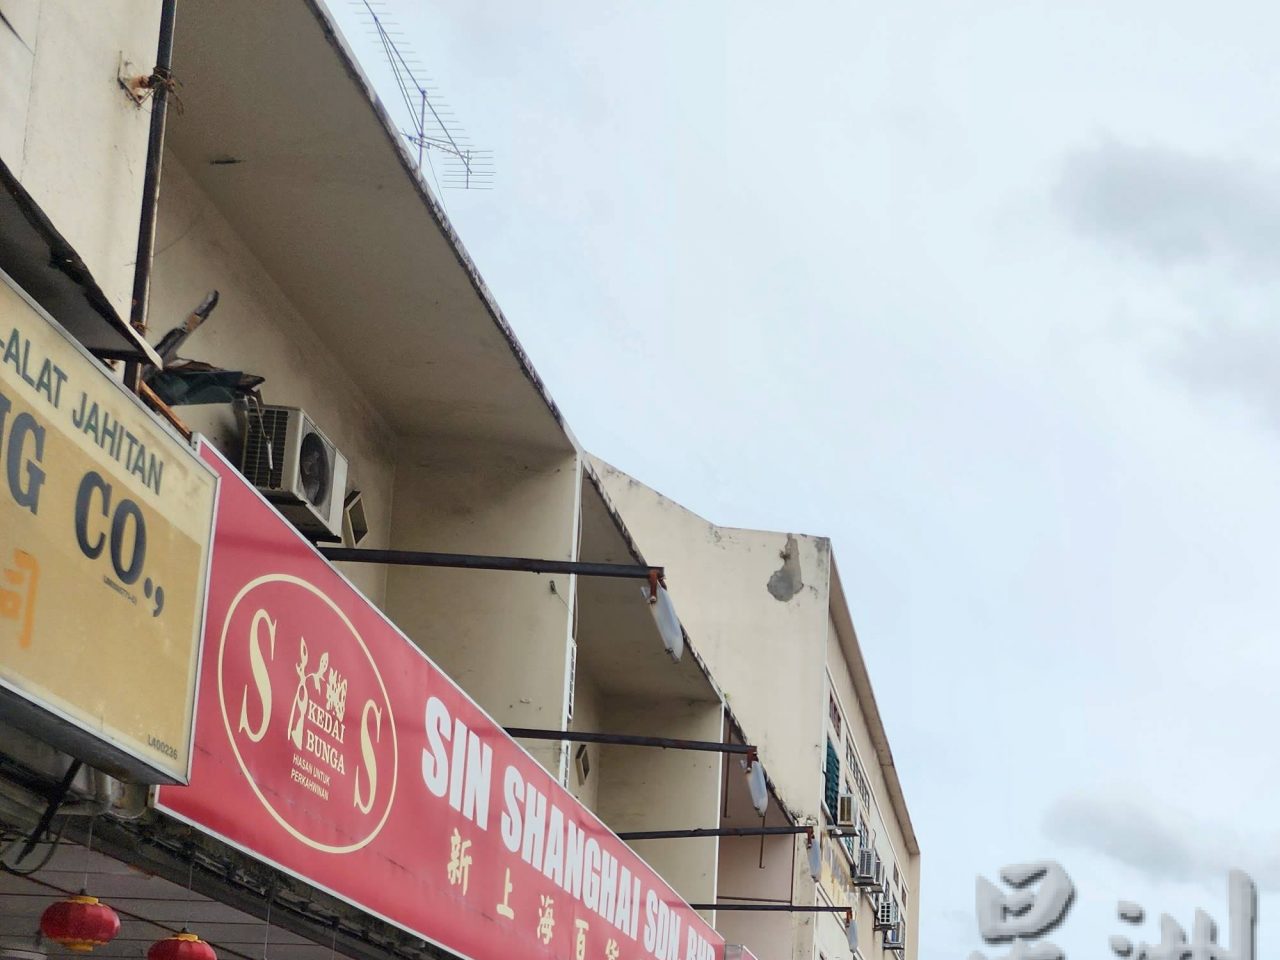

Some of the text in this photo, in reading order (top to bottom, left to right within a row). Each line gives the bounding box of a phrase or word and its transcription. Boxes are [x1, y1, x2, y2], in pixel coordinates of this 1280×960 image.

[72, 391, 164, 497] JAHITAN
[238, 608, 278, 743] S
[305, 729, 346, 776] BUNGA
[308, 699, 346, 744] KEDAI
[353, 698, 383, 815] S
[290, 767, 330, 801] PERKAHWINAN
[292, 753, 331, 787] HIASAN UNTUK
[422, 696, 493, 832] SIN
[501, 765, 641, 941] SHANGHAI
